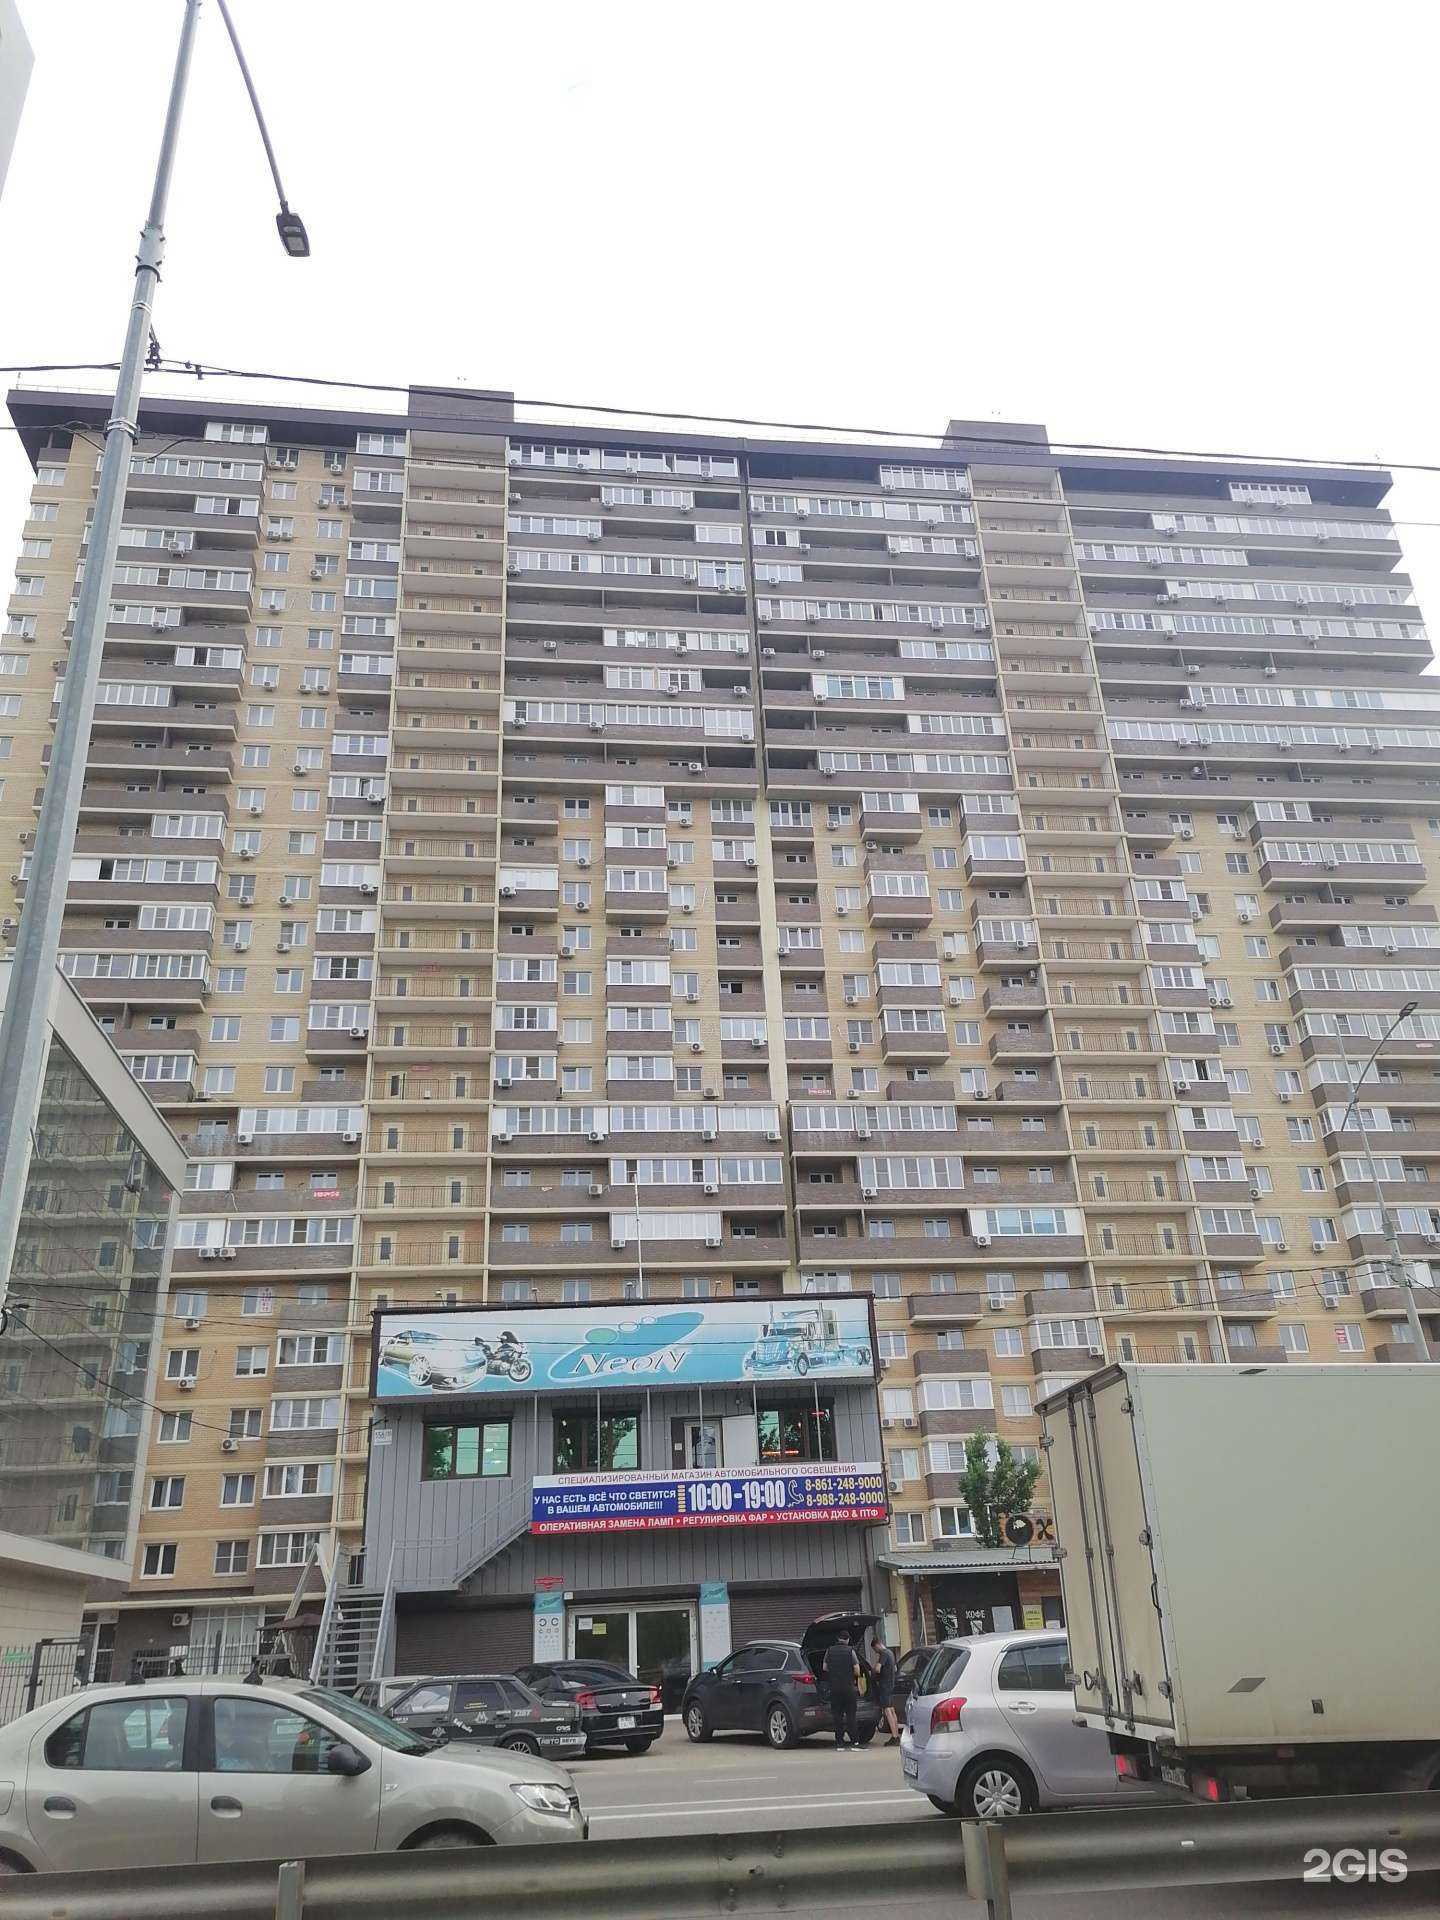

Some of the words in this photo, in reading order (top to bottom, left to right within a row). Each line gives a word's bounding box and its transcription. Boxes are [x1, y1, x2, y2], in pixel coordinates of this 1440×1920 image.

[558, 1471, 669, 1485] СПЕЦИАЛИЗИРОВАННЫЙ
[671, 1470, 712, 1480] МАГАЗИН
[715, 1466, 799, 1478] АВТОМОБИЛЬНОГО
[800, 1464, 857, 1474] ОСВЕЩЕНИЯ
[805, 1476, 882, 1491] 8-861-248-9000
[534, 1495, 541, 1504] У
[542, 1495, 561, 1504] НАС
[563, 1494, 586, 1503] ЕСТЬ
[588, 1491, 606, 1502] ВСЁ
[609, 1491, 627, 1501] ЧТО
[629, 1489, 676, 1500] СВЕТИТСЯ
[806, 1491, 884, 1507] 8-988-248-9000
[547, 1506, 554, 1514] В
[556, 1504, 590, 1514] ВАШЕМ
[592, 1501, 663, 1513] АВТОМОБИЛЕ!!!
[776, 1511, 828, 1521] УСТАНОВКА
[831, 1510, 850, 1519] ДХО
[851, 1510, 858, 1518] &
[860, 1509, 879, 1518] ПТФ
[540, 1520, 606, 1532] ОПЕРАТИВНАЯ
[608, 1518, 646, 1528] ЗАМЕНА
[648, 1517, 674, 1527] ЛАМП
[683, 1514, 747, 1525] РЕГУЛИРОВКА
[749, 1513, 768, 1521] ФАР
[965, 1609, 986, 1620] КОФЕ
